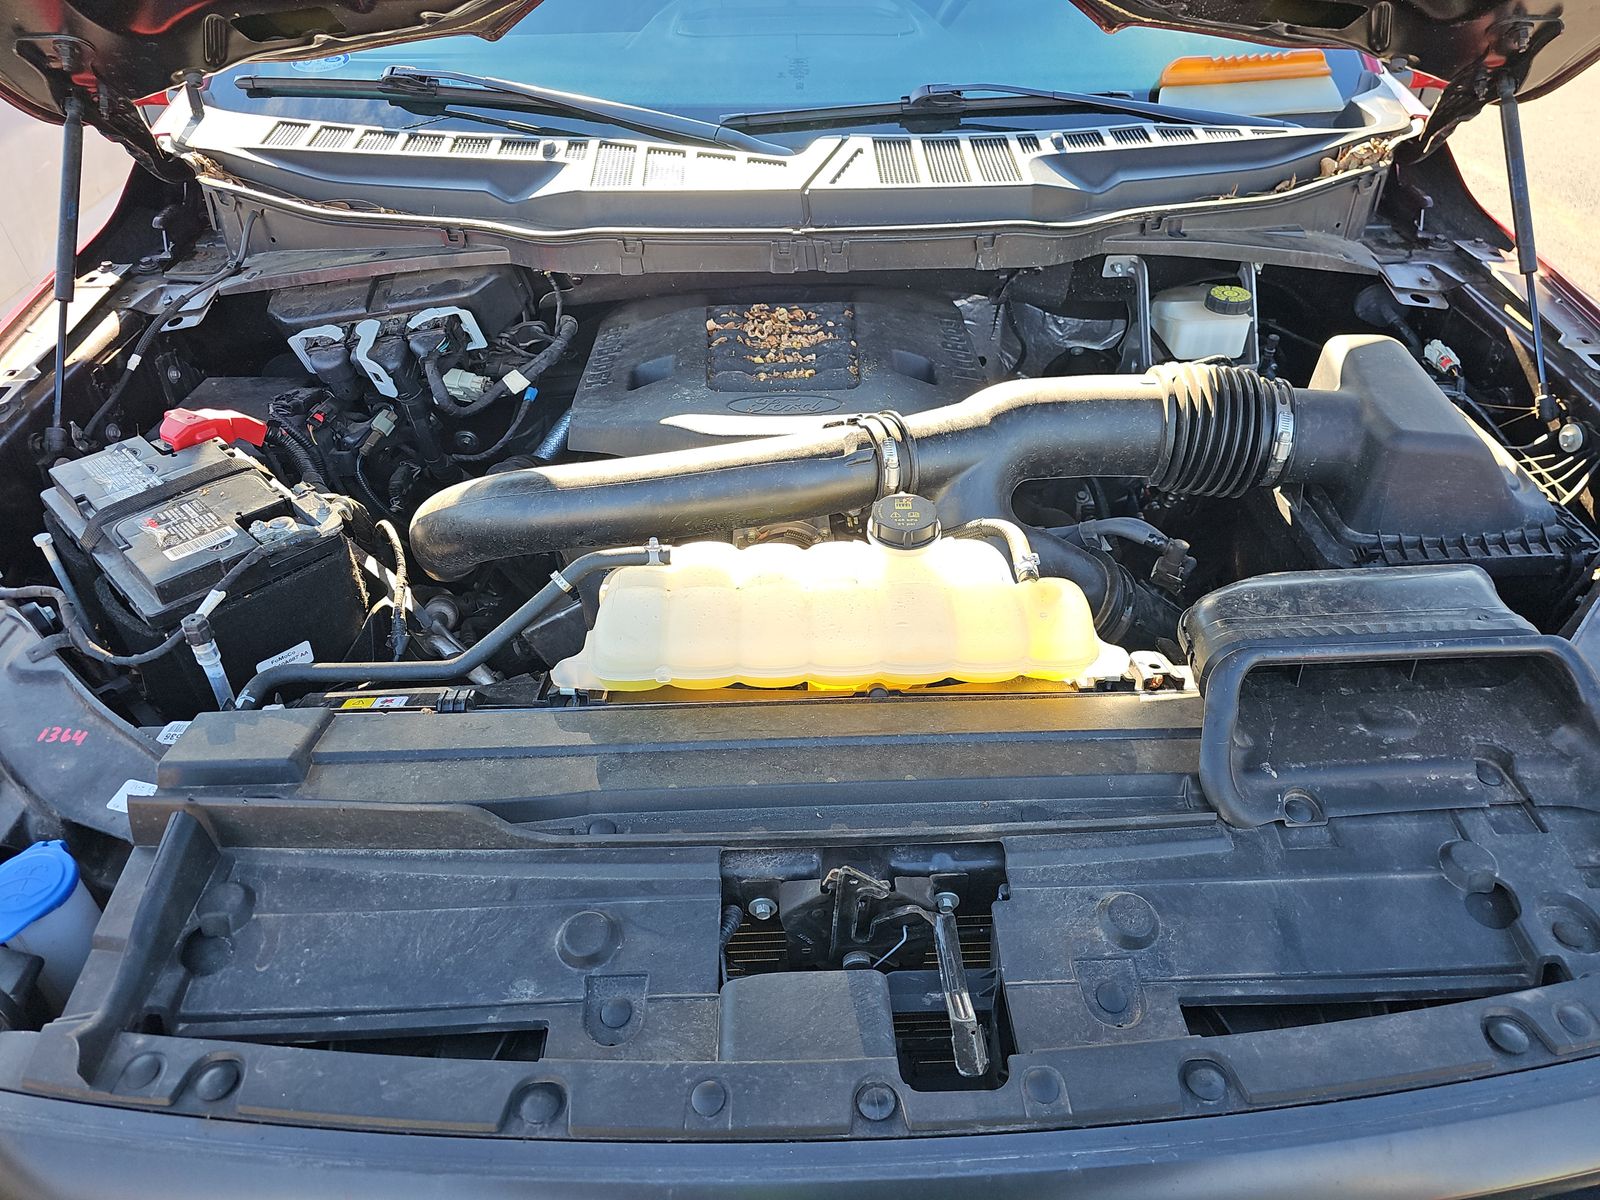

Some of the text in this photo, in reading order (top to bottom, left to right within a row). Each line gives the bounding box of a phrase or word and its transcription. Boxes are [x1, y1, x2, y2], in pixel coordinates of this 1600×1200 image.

[750, 397, 823, 414] Ford
[271, 651, 295, 665] FoMoCo
[36, 726, 89, 746] 1364
